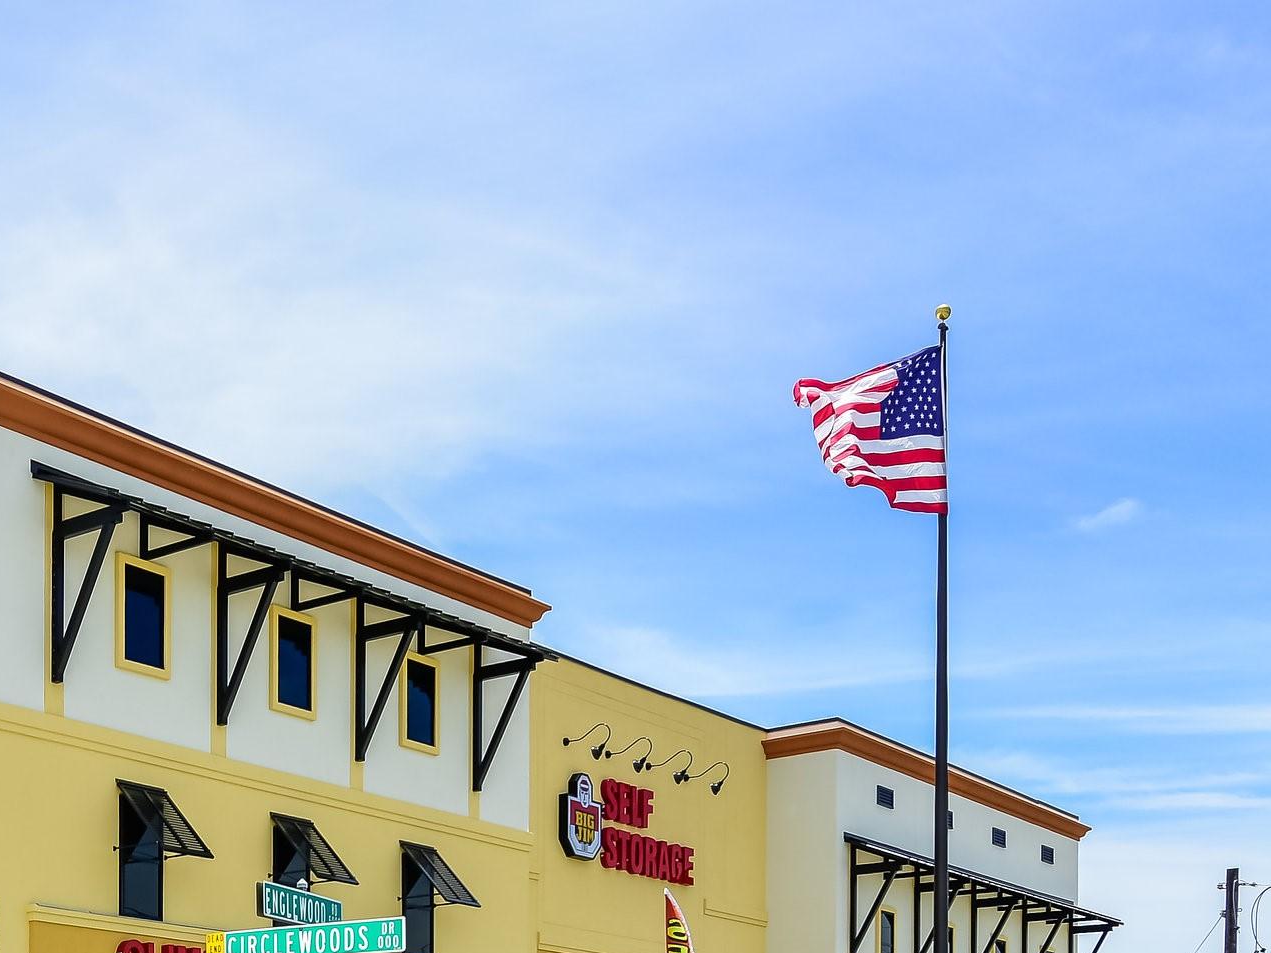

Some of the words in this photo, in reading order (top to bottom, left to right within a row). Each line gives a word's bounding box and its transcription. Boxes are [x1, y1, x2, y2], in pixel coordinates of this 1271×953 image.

[600, 778, 654, 829] SELF
[575, 810, 595, 829] BIG
[576, 826, 595, 844] JIM
[600, 826, 694, 886] STORAGE
[265, 887, 326, 923] ENGLEWOOD
[382, 921, 395, 935] DR
[207, 934, 224, 943] DEAD
[378, 935, 399, 948] 000
[210, 945, 222, 953] END
